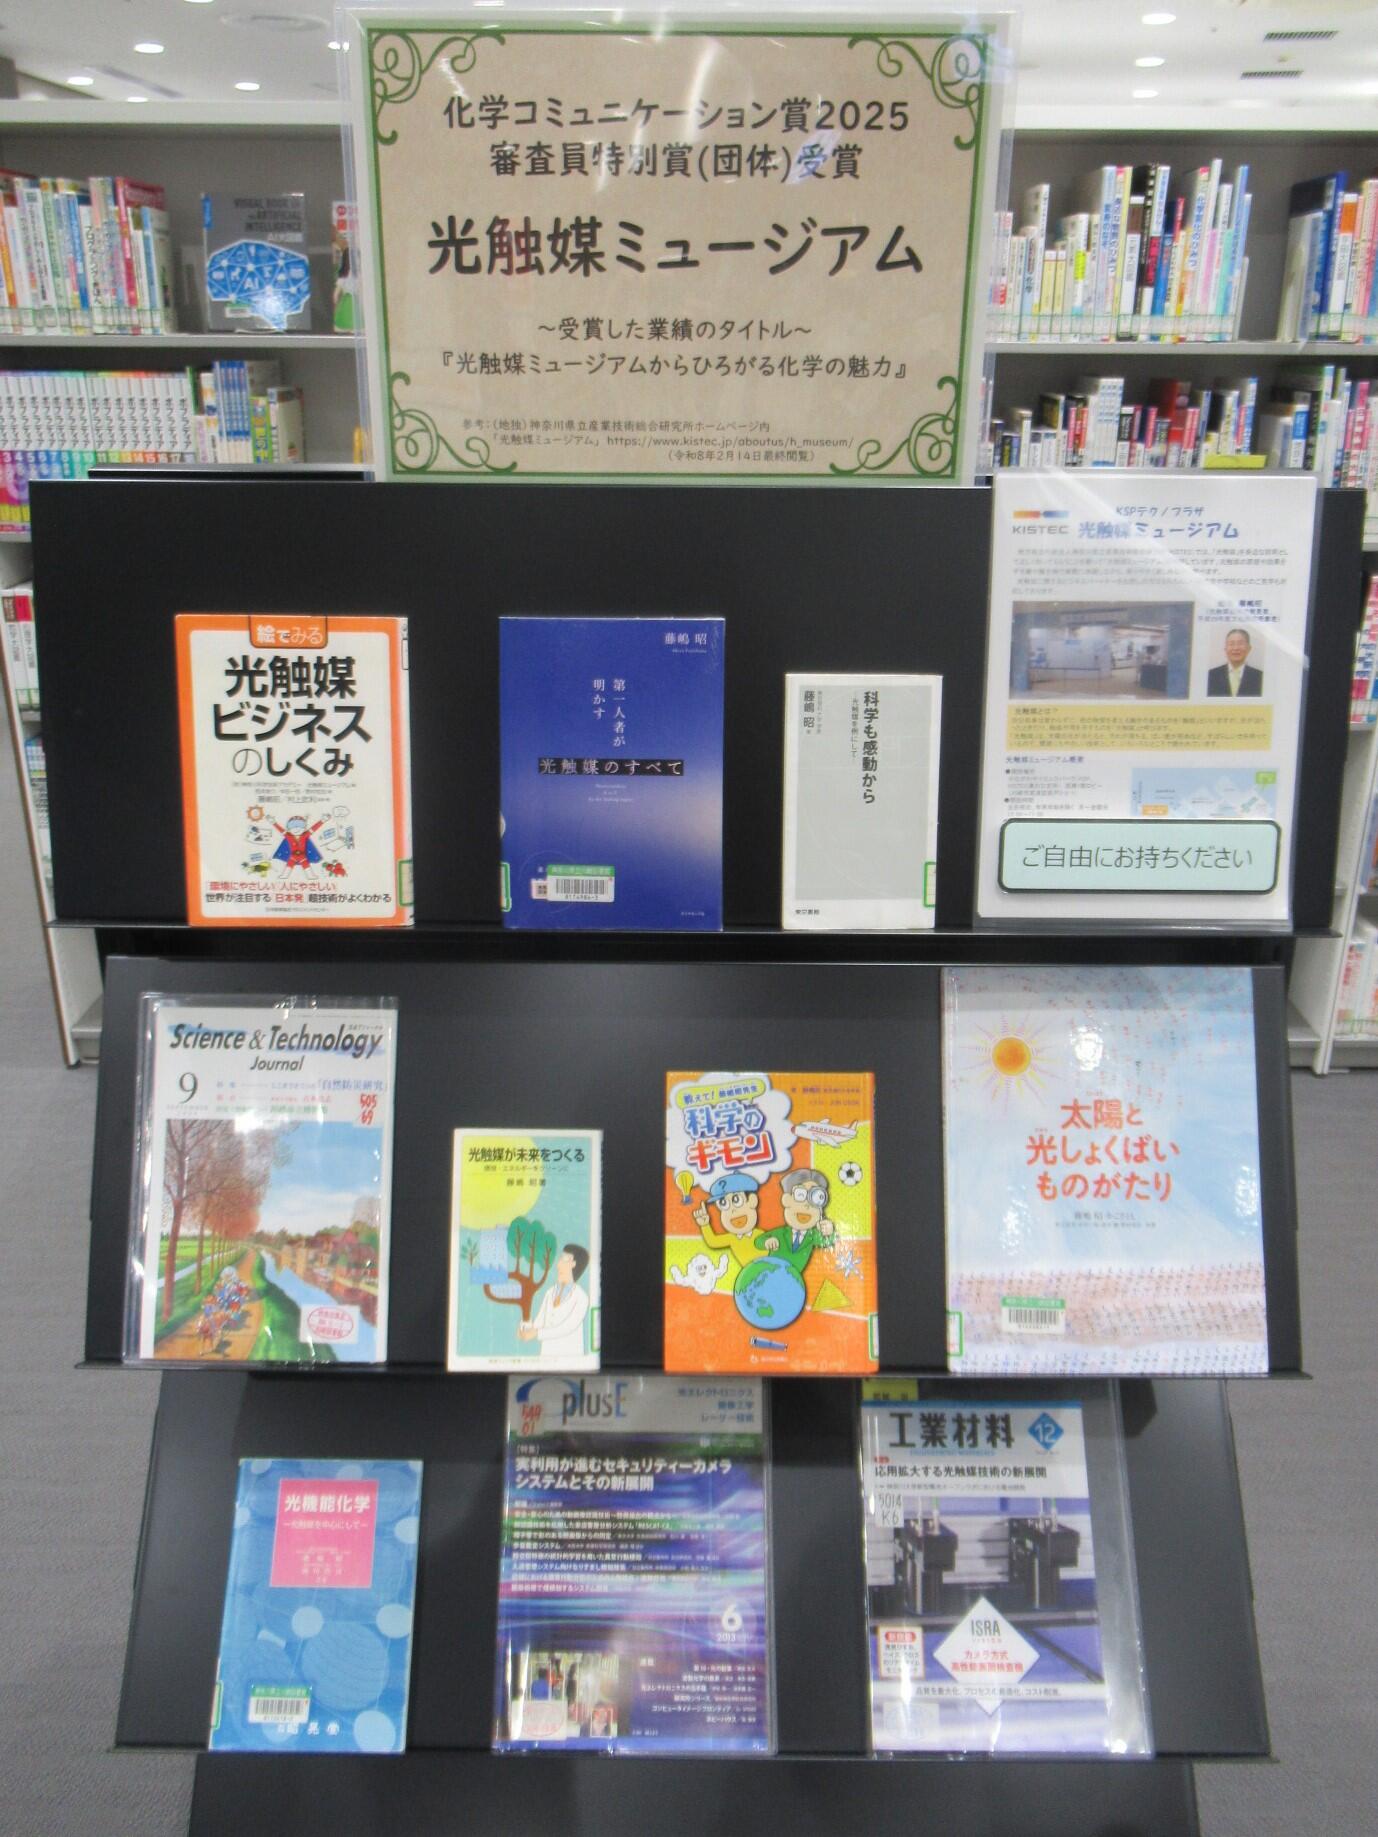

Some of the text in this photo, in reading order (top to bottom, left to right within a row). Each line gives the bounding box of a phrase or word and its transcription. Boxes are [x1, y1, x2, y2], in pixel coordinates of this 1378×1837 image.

[443, 96, 910, 133] 化学コミュニケーション賞2025
[490, 142, 863, 181] 審査員特別賞(団体)受賞
[426, 215, 924, 277] 光触媒ミュージアム
[441, 351, 909, 379] 『光触媒ミュージアムからひろがる化学の魅力』
[1012, 525, 1070, 535] KISTEC
[256, 624, 324, 644] 絵でみる
[224, 654, 357, 699] 光触媒
[593, 678, 606, 720] 明かす
[613, 678, 626, 748] 第一人者が
[213, 701, 373, 743] ビジネス
[232, 747, 354, 778] のしくみ
[862, 690, 879, 804] 科学も感動から
[540, 758, 683, 775] 光触媒のすべて
[1022, 843, 1253, 870] ご自由にお持ちください
[170, 1023, 384, 1059] Science & Technology
[249, 1056, 305, 1071] Journal
[178, 1072, 199, 1104] 9
[685, 1102, 764, 1137] 科学の
[1060, 1098, 1144, 1130] 太陽と
[468, 1147, 585, 1162] 光触媒が未来をつくる
[687, 1131, 773, 1171] ギモン
[1026, 1135, 1181, 1166] 光しょくばい
[1036, 1172, 1173, 1201] ものがたり
[888, 1412, 1015, 1449] 工業材料
[1035, 1423, 1056, 1443] 12
[515, 1456, 733, 1474] 実利用が進むセキュリティーカメラ
[875, 1465, 1047, 1479] 応用拡大する光触媒技術の新展開
[515, 1475, 655, 1491] システムとその新展開
[285, 1494, 370, 1514] 光機能化学
[721, 1603, 743, 1632] 6
[971, 1620, 1001, 1636] ISRA
